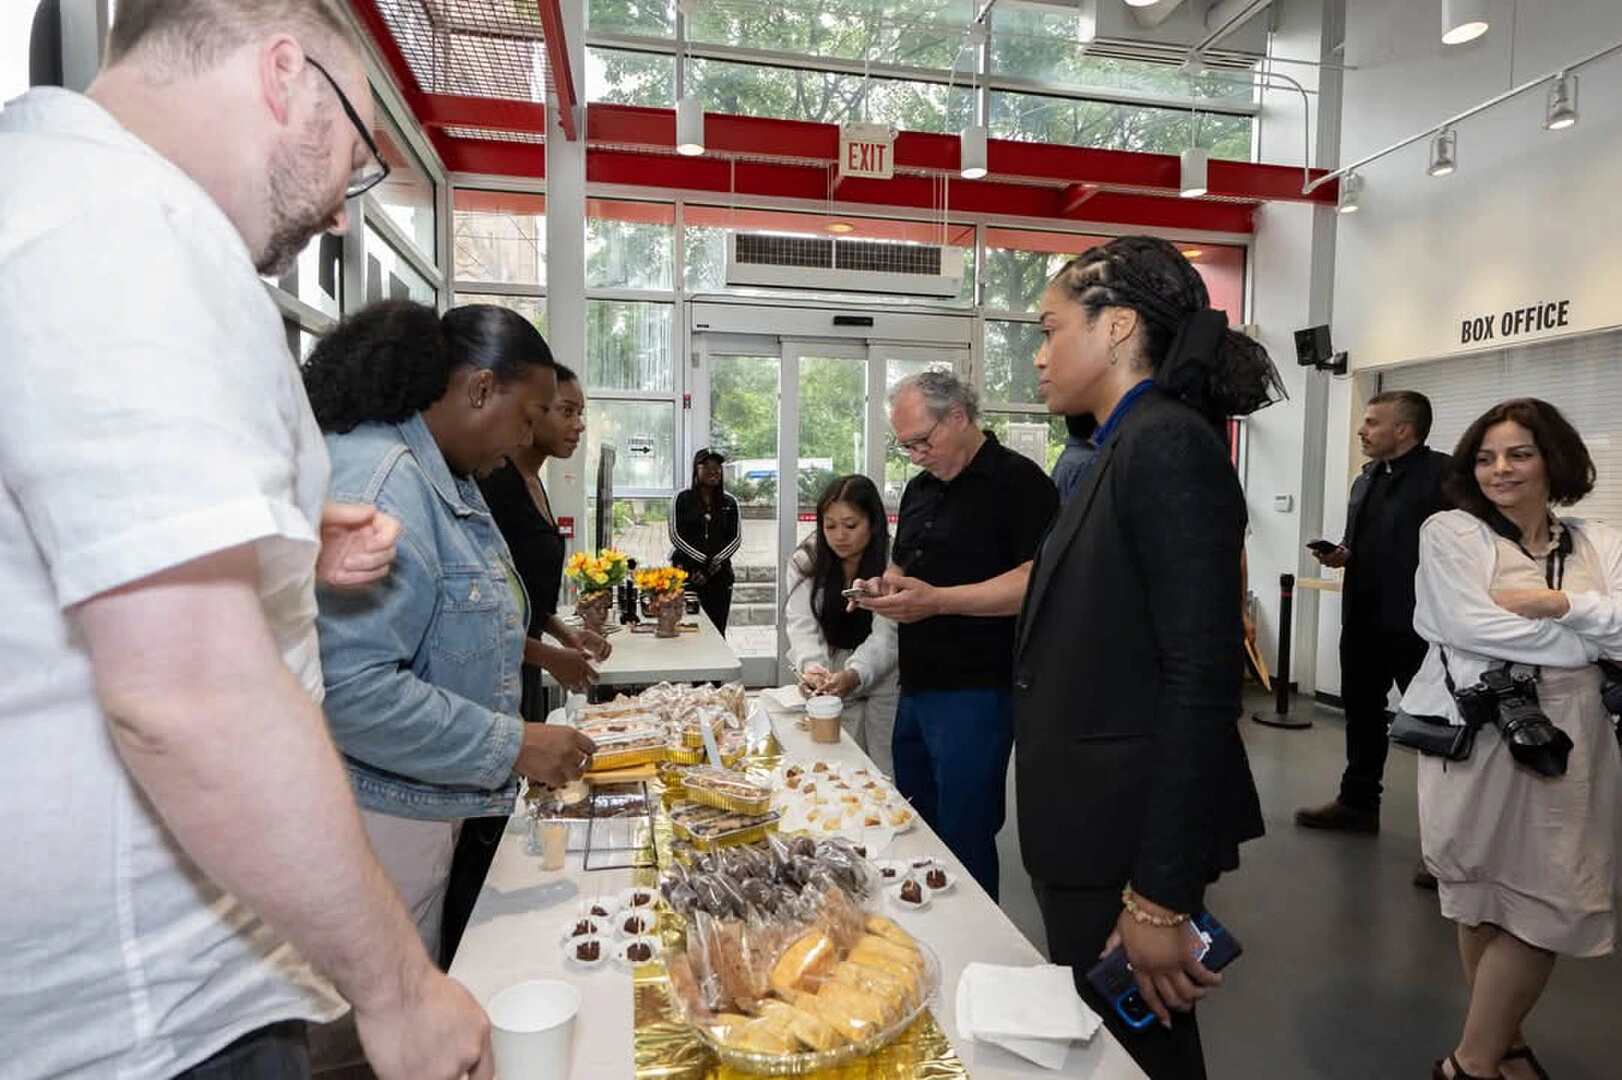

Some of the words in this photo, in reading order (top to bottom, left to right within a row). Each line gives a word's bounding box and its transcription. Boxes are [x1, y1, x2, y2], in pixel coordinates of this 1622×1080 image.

[848, 142, 886, 172] EXIT
[1461, 315, 1494, 343] BOX
[1501, 300, 1570, 336] OFFICE
